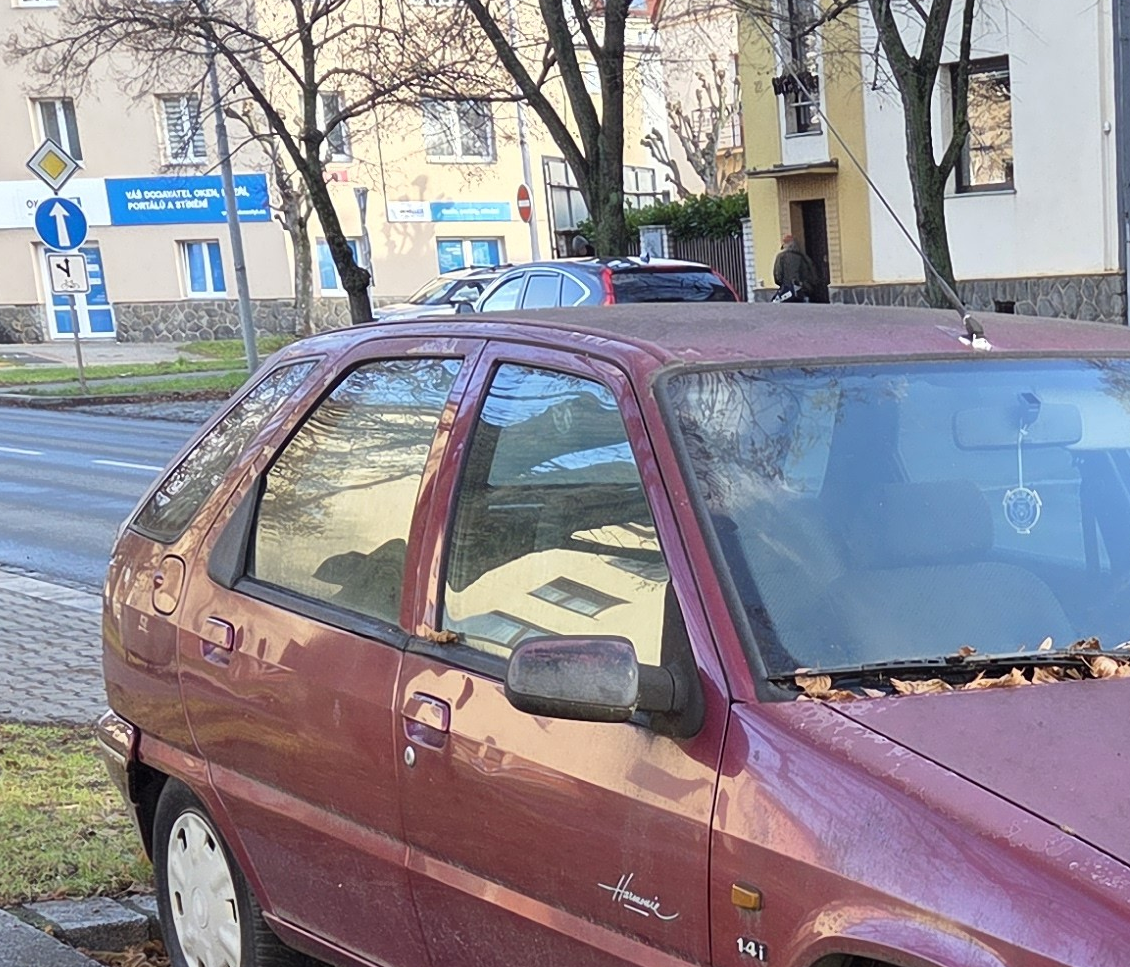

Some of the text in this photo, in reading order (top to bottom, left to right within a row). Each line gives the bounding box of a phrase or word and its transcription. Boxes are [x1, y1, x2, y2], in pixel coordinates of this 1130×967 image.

[125, 188, 143, 200] VÁŠ
[144, 189, 192, 200] DODAVATEL
[128, 199, 165, 210] PORTÁLŮ
[168, 200, 175, 209] A
[597, 872, 679, 920] Harmonie
